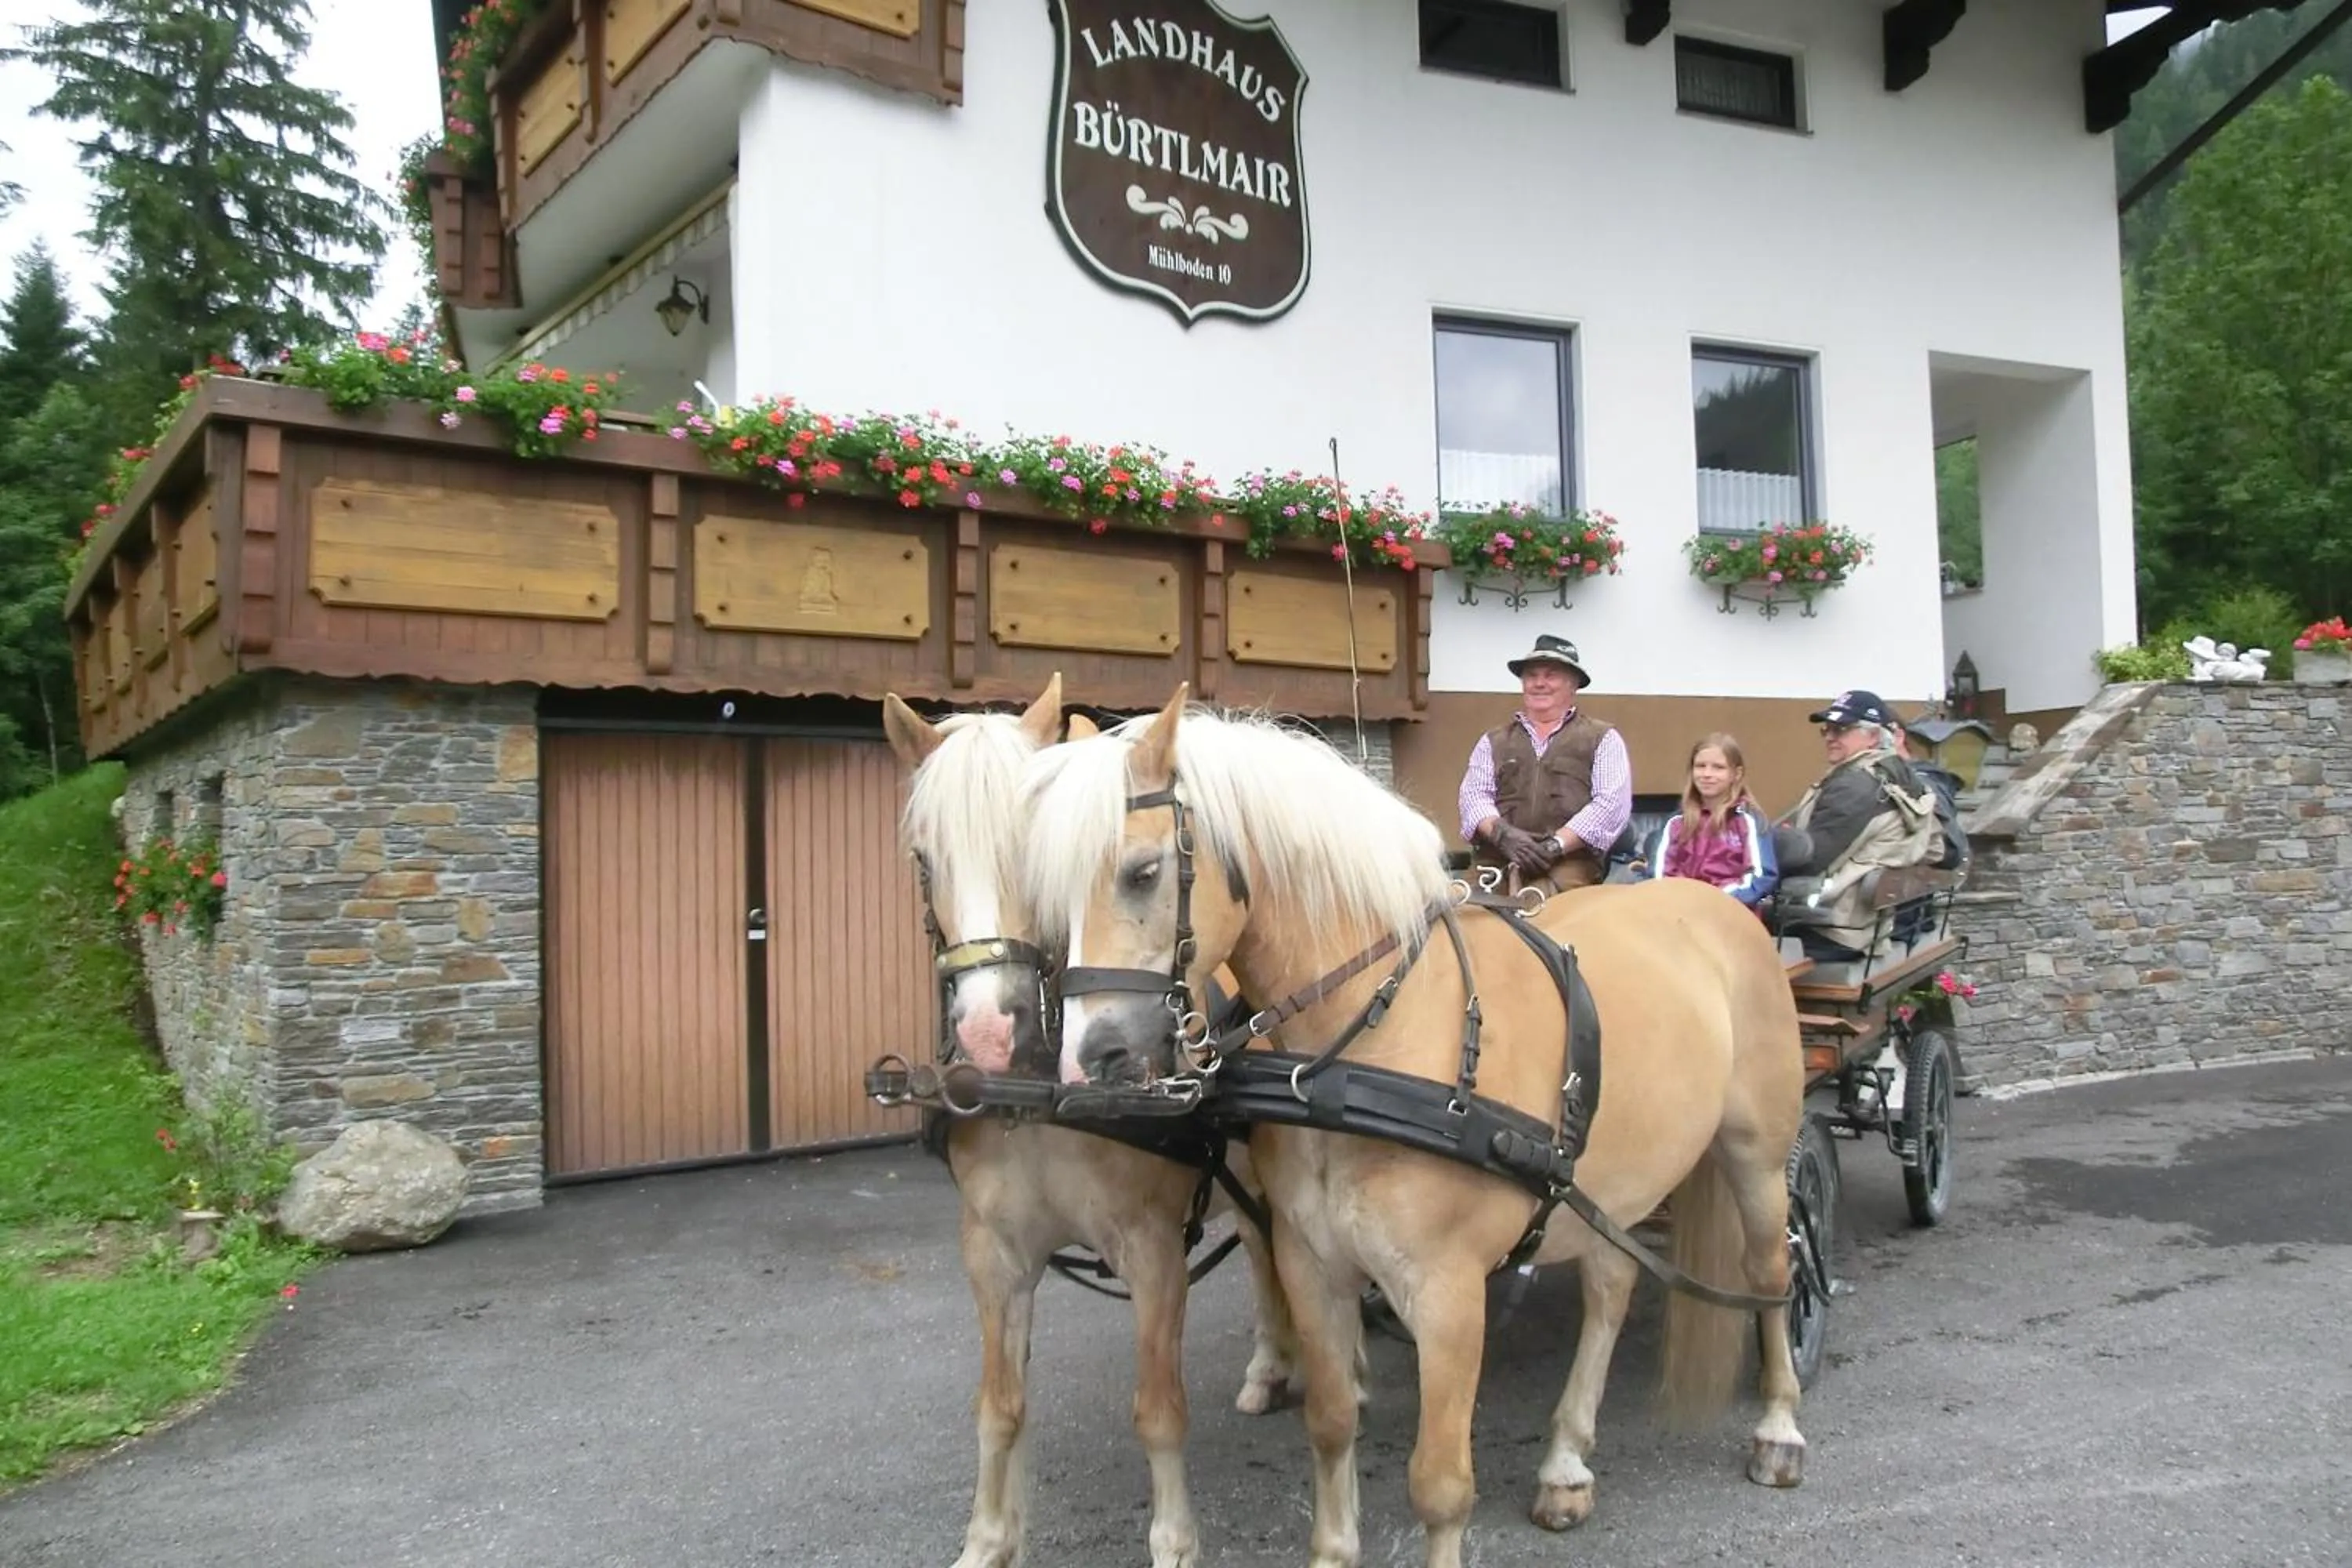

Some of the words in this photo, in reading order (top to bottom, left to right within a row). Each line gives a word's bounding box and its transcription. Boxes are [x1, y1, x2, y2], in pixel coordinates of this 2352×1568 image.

[1081, 17, 1286, 122] LANDHAUS
[1073, 100, 1291, 208] BÜRTLMAIR
[1148, 244, 1214, 281] Mühlboden
[1218, 264, 1232, 285] 10
